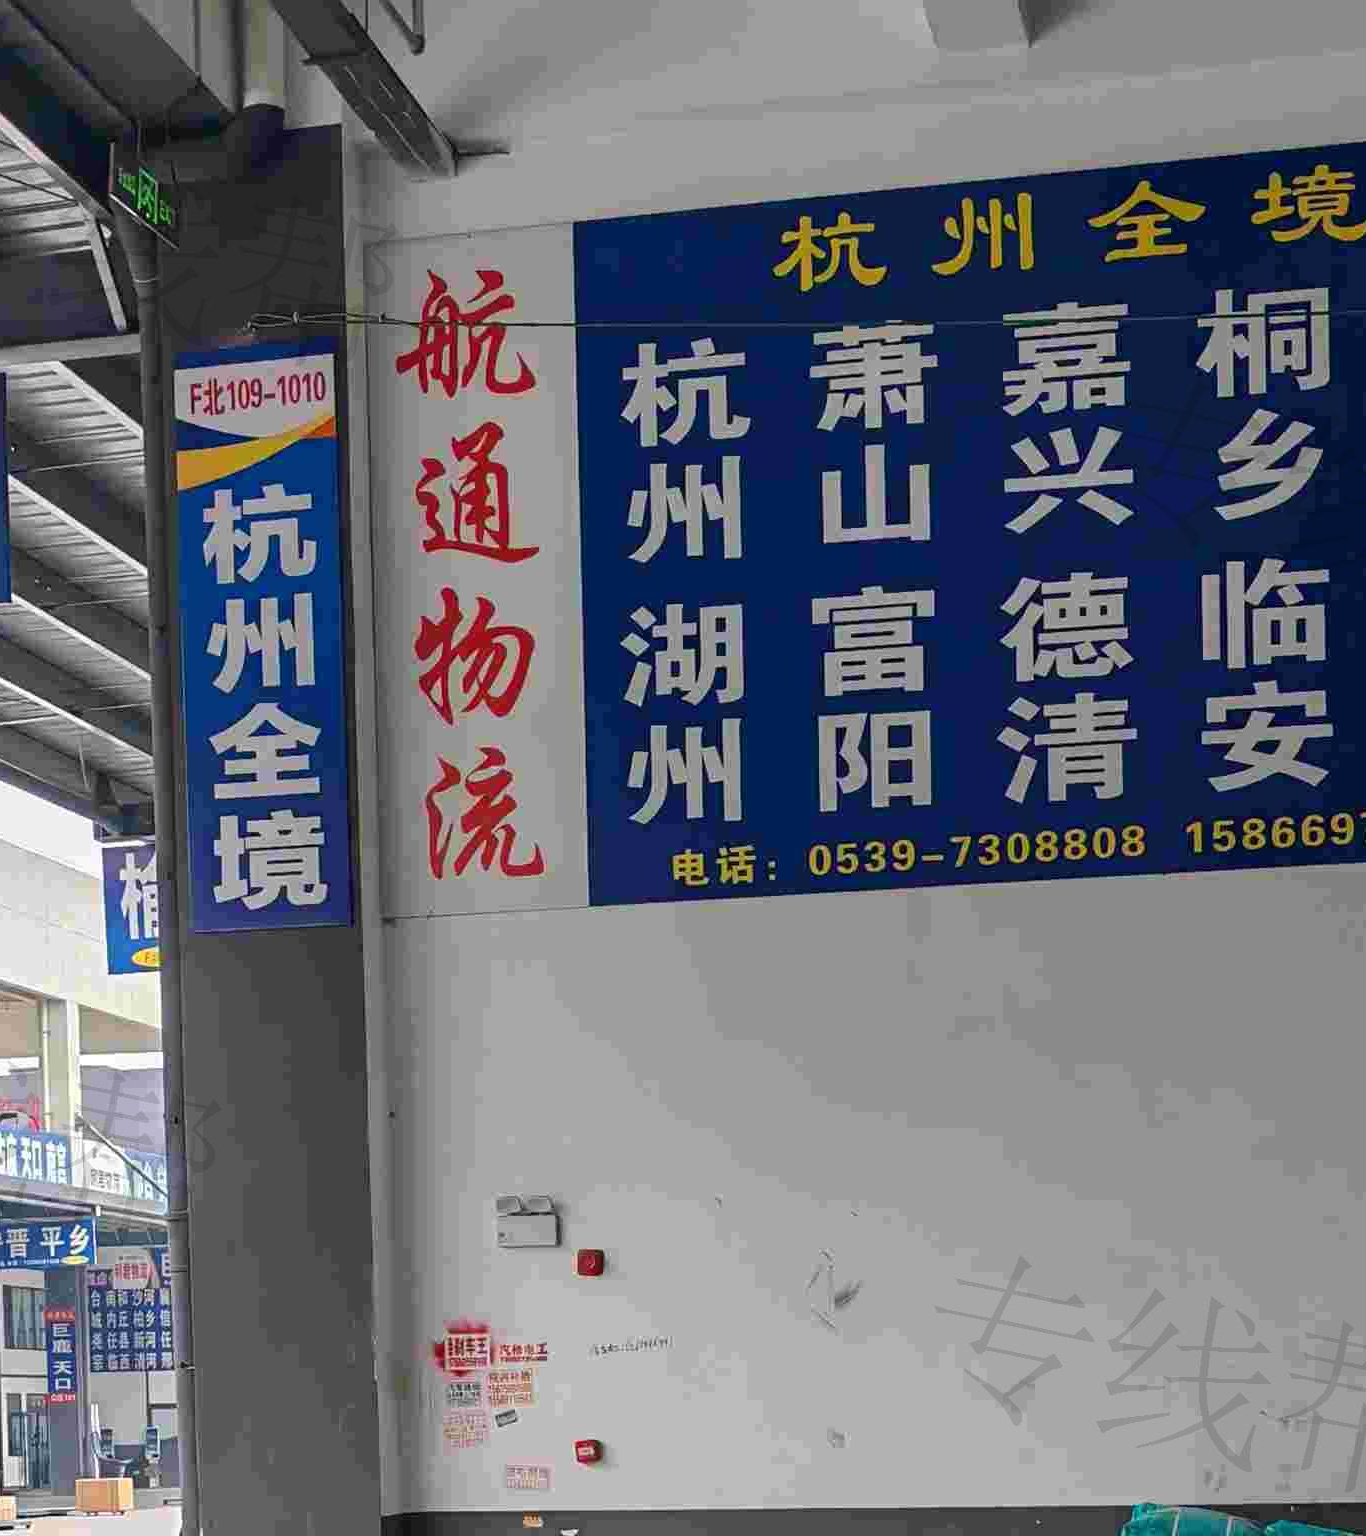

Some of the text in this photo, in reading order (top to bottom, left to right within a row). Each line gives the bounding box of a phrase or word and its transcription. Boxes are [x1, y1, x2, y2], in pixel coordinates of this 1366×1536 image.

[189, 370, 327, 417] F北109-1010
[621, 338, 750, 565] 杭州
[808, 319, 937, 545] 萧山
[1002, 303, 1134, 532] 嘉兴
[1196, 287, 1329, 521] 桐乡
[395, 268, 546, 879] 航通物流
[1201, 557, 1334, 792] 临安
[202, 483, 329, 910] 杭州全境
[619, 602, 745, 824] 湖州
[812, 584, 935, 811] 富阳
[995, 571, 1138, 804] 德清
[39, 1220, 91, 1258] 平乡
[52, 1360, 73, 1390] 天口
